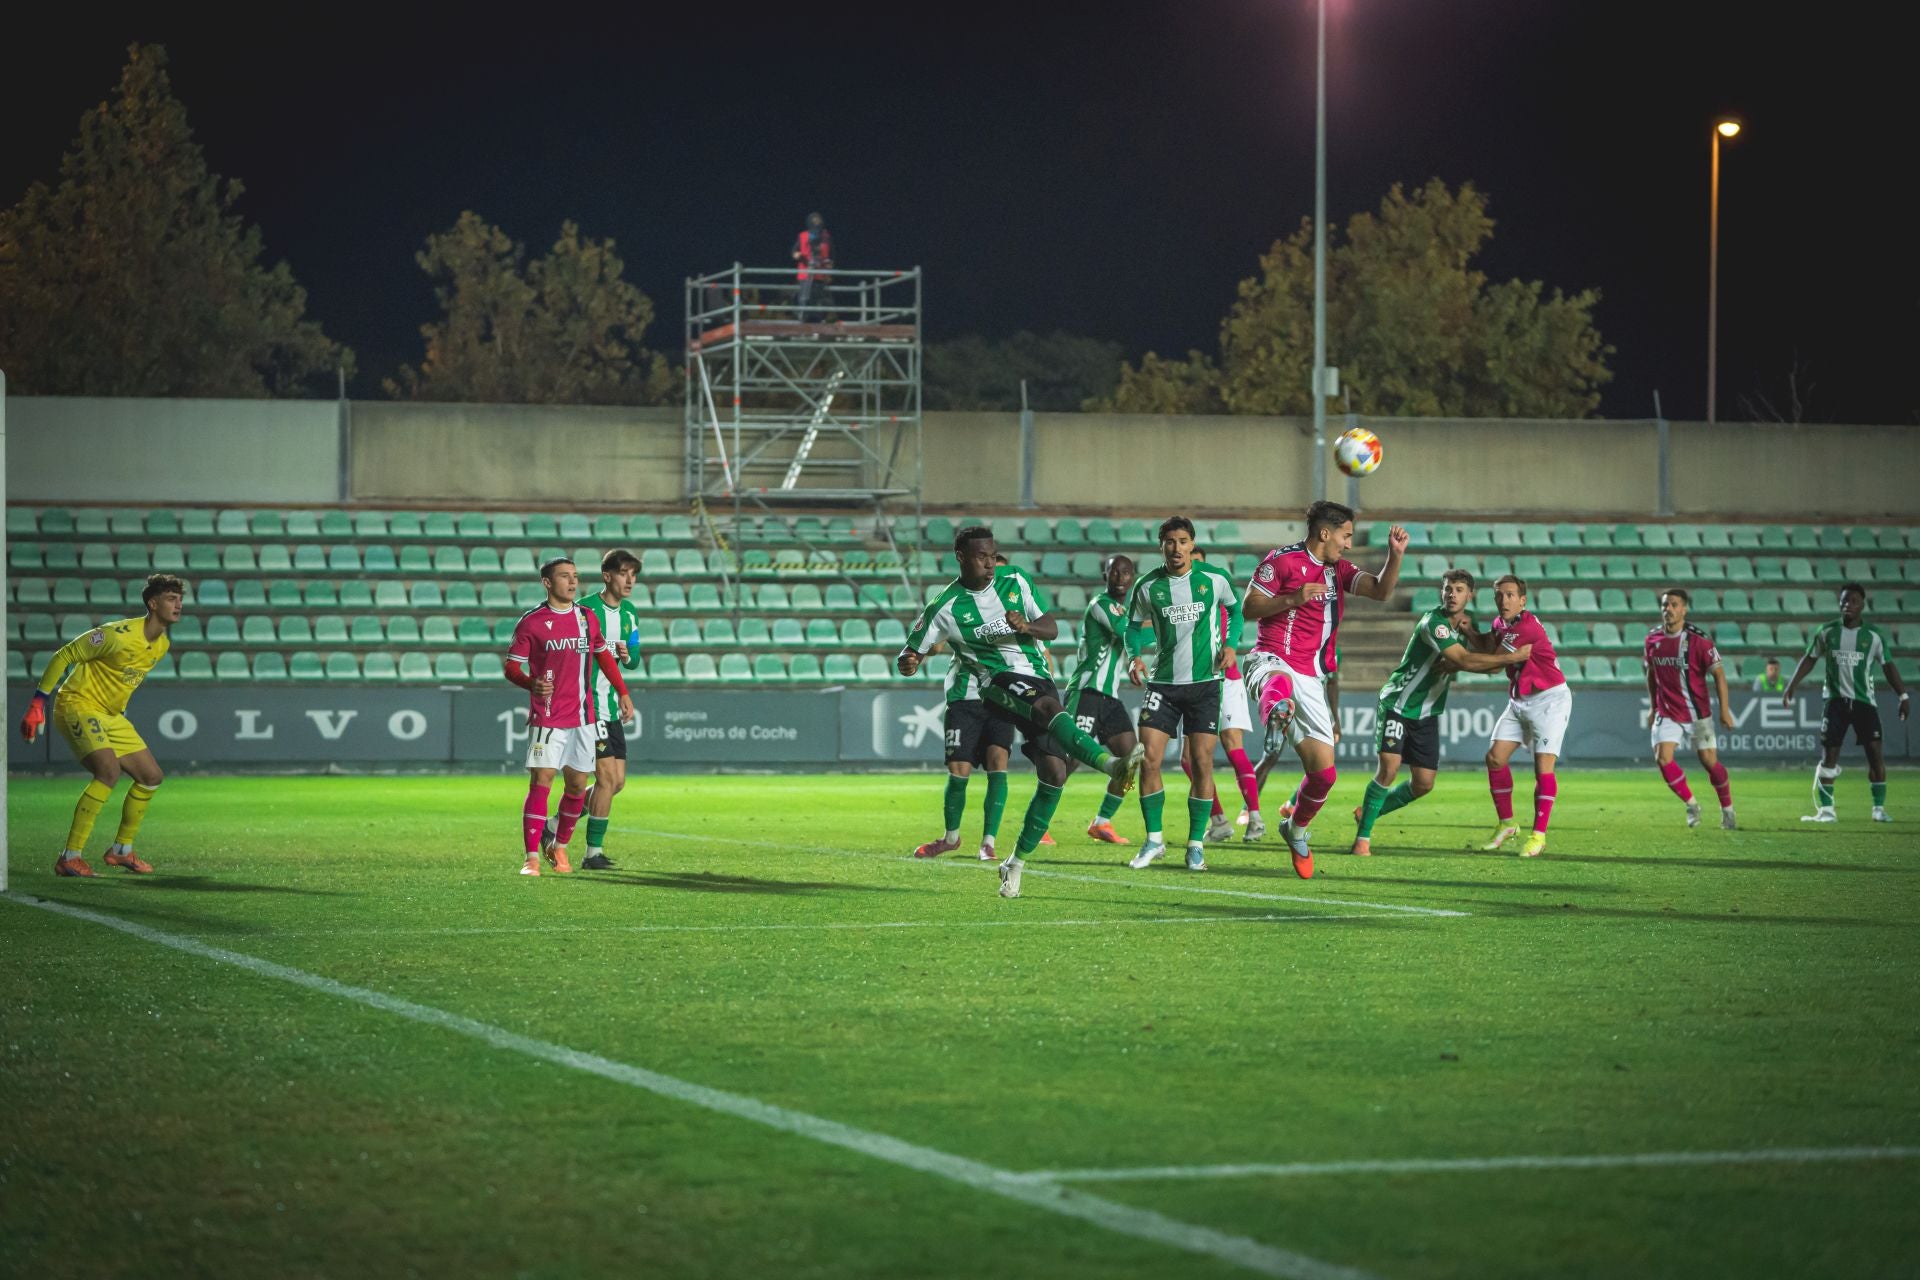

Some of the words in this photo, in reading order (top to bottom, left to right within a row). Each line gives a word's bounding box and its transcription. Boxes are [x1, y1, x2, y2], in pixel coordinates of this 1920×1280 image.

[1163, 601, 1204, 618] FOREVER
[1171, 612, 1199, 623] GREEN
[545, 637, 590, 651] AVATEL
[1009, 681, 1033, 696] 11
[157, 709, 428, 741] OLVO
[1076, 715, 1096, 733] 25
[1384, 719, 1404, 740] 20
[664, 724, 726, 742] Seguros
[727, 726, 747, 740] de
[750, 725, 798, 740] Coche
[944, 729, 961, 747] 21
[1731, 735, 1750, 750] DE
[1754, 734, 1816, 750] COCHES
